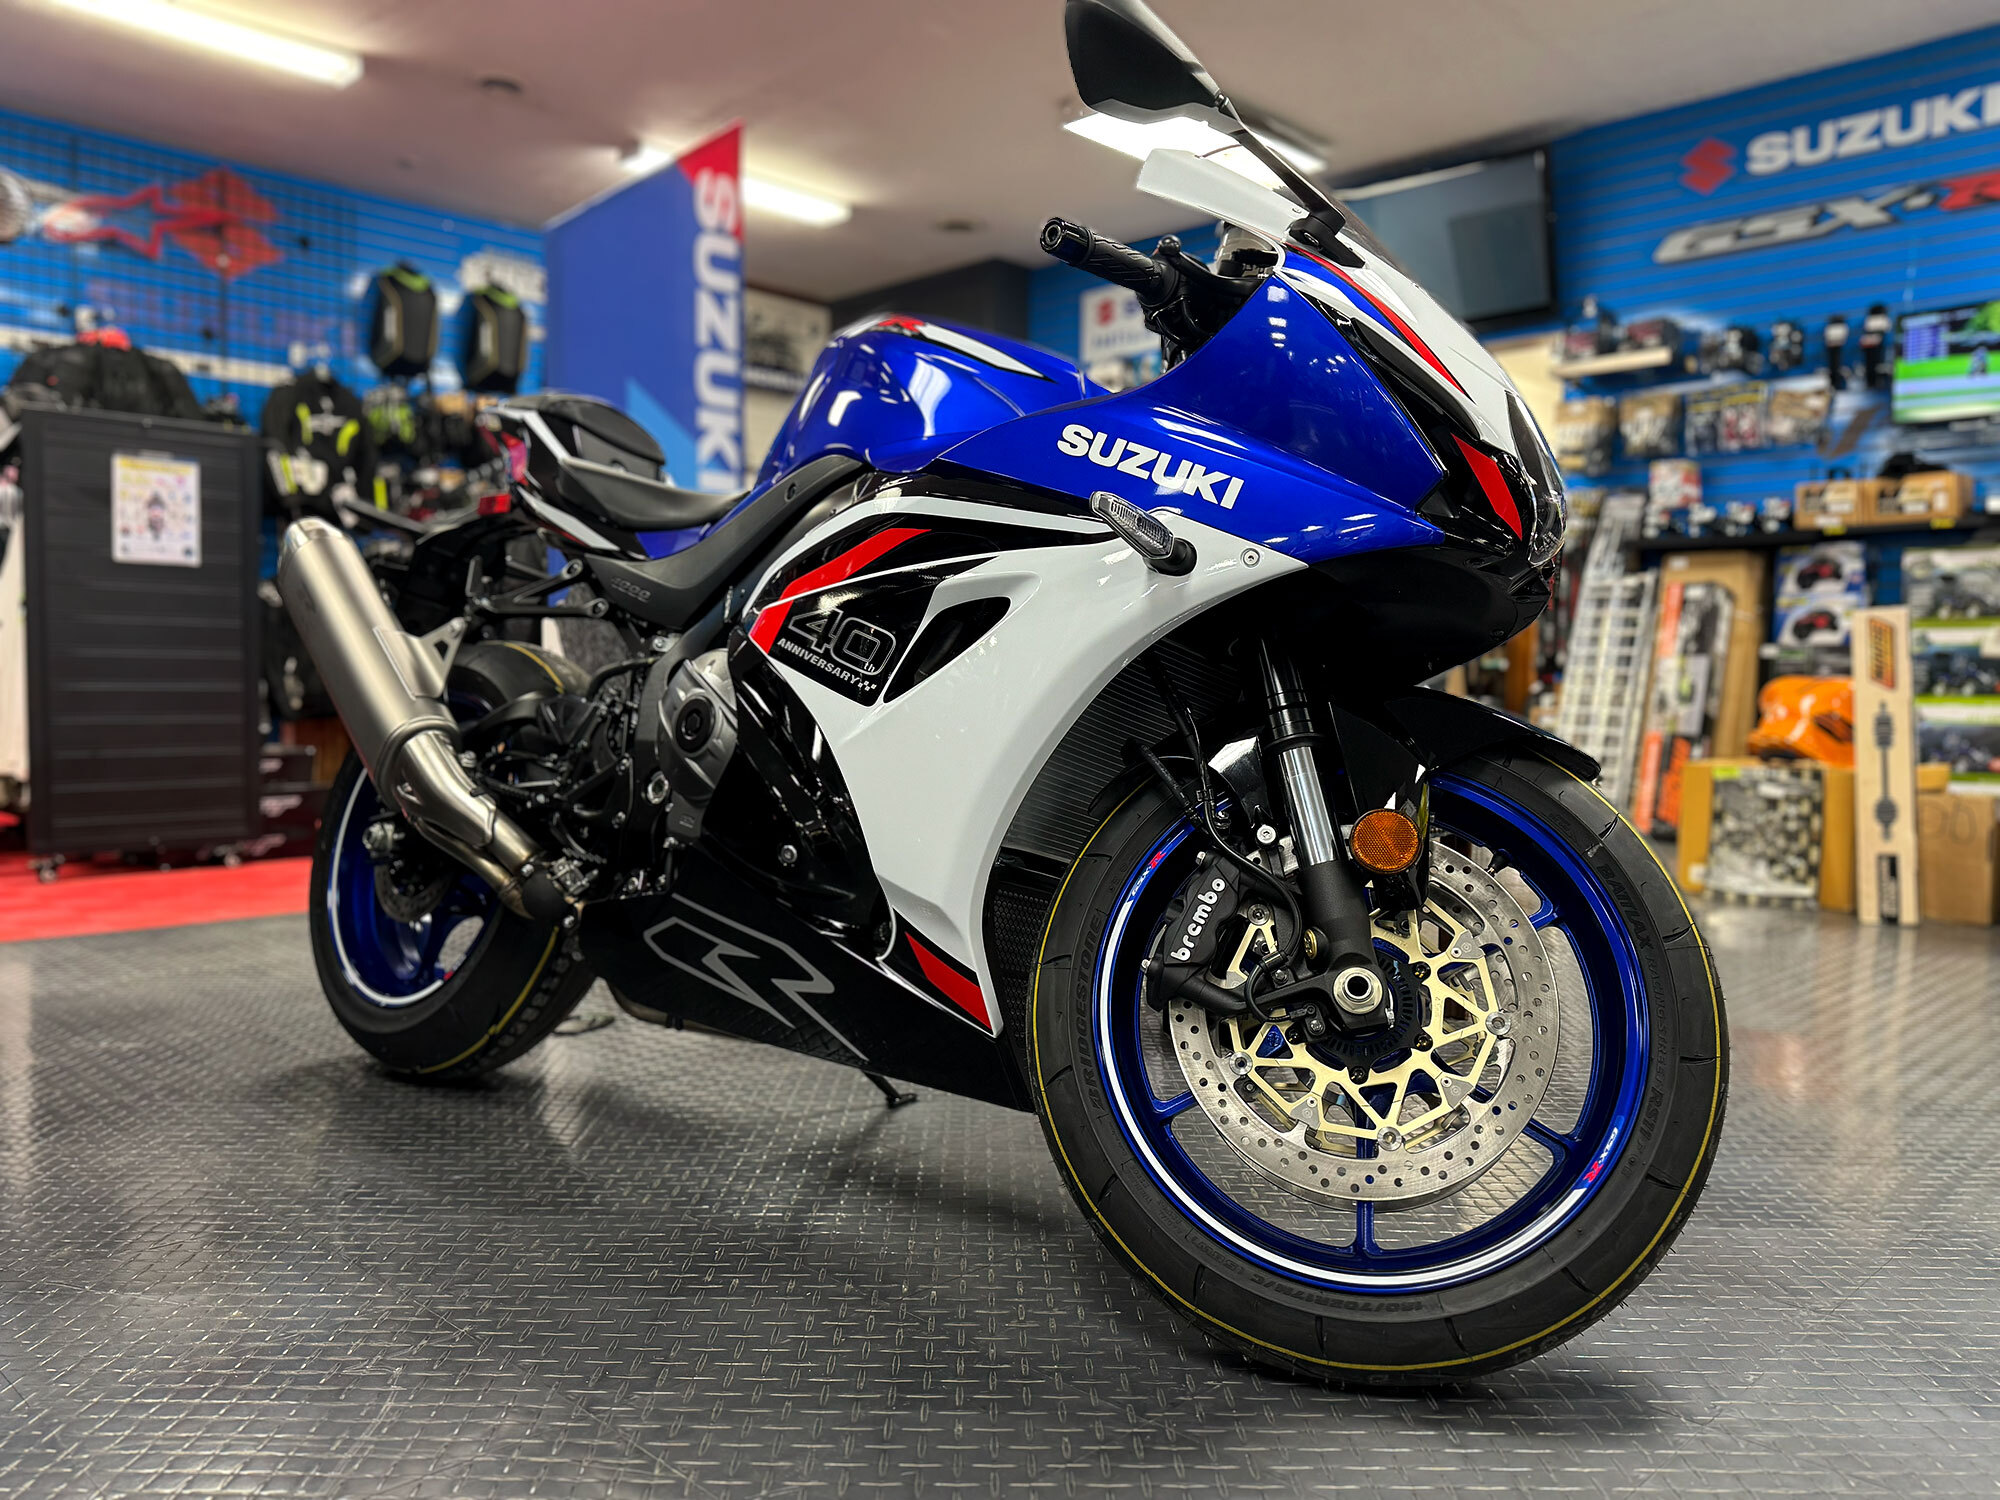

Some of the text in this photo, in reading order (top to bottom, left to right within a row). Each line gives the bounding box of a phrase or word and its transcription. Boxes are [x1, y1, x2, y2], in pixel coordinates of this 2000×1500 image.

[1746, 82, 2000, 175] SUZUKI
[693, 167, 741, 492] SUZUKI
[1056, 424, 1245, 510] SUZUKI
[777, 638, 860, 685] ANNIVERSARY
[1170, 878, 1226, 961] brembo
[1598, 864, 1652, 950] BATTLAX
[1075, 911, 1105, 1112] BRIDGESTONE
